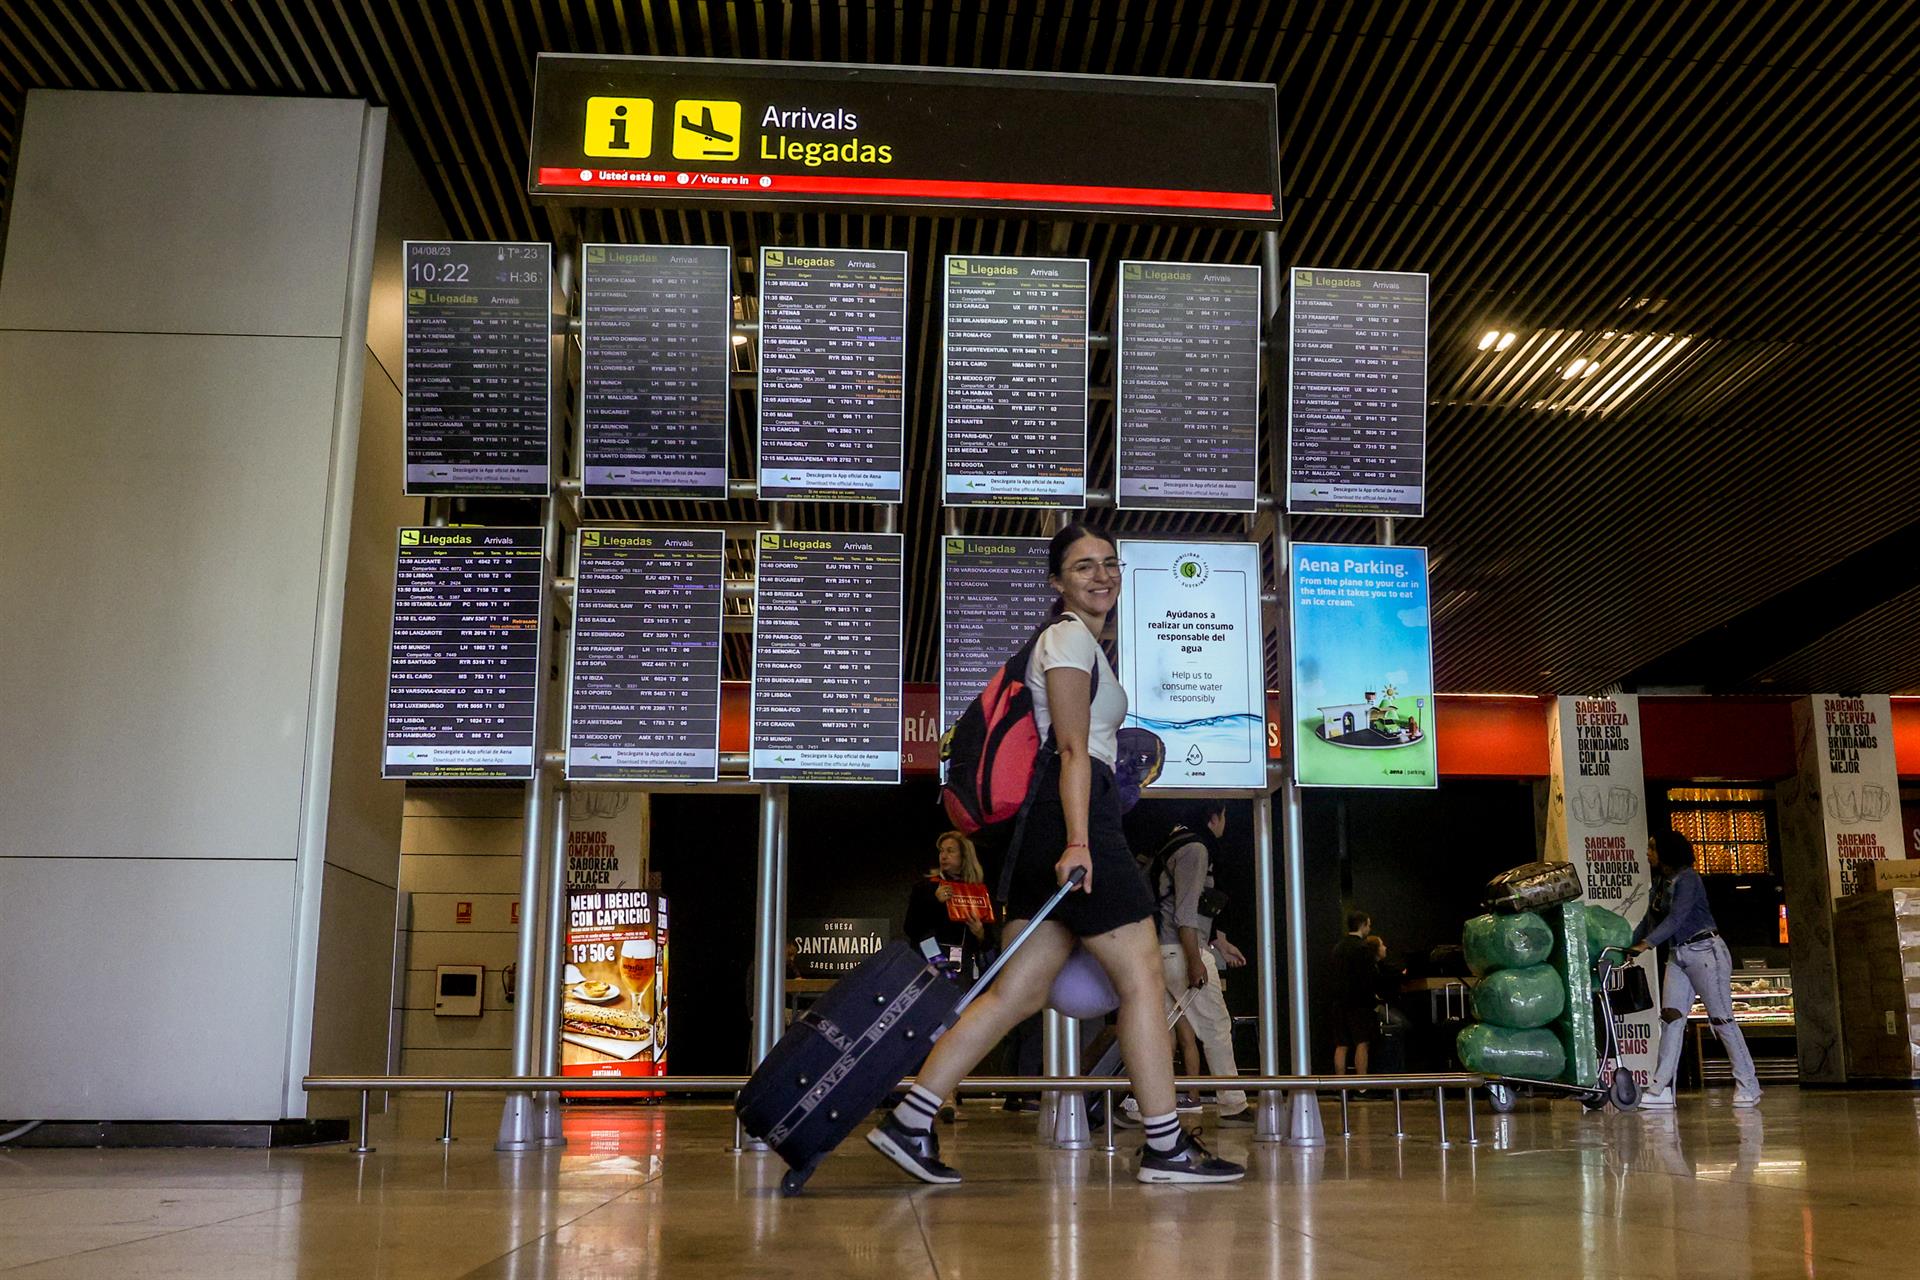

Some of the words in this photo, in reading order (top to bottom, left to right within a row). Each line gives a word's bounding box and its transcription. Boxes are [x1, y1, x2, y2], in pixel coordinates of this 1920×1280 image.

[761, 105, 857, 130] Arrivals
[760, 135, 892, 167] Llegadas
[599, 170, 628, 181] Usted
[630, 170, 651, 182] está
[653, 174, 665, 182] en
[700, 174, 719, 185] You
[721, 176, 738, 185] are
[740, 175, 749, 185] in
[412, 247, 451, 255] 04/08/23
[609, 253, 657, 263] Llegadas
[670, 256, 698, 264] Arrivals
[787, 256, 835, 268] Llegadas
[847, 260, 876, 269] Arrivals
[411, 263, 469, 282] 10:22
[971, 265, 1018, 275] Llegadas
[1030, 269, 1059, 277] Arrivals
[1145, 271, 1192, 281] Llegadas
[1204, 274, 1231, 282] Arrivals
[1316, 277, 1361, 287] Llegadas
[1373, 281, 1399, 289] Arrivals
[430, 293, 479, 304] Llegadas
[423, 535, 472, 545] Llegadas
[484, 537, 513, 545] Arrivals
[603, 536, 652, 546] Llegadas
[783, 539, 832, 550] Llegadas
[968, 544, 1016, 554] Llegadas
[1028, 547, 1050, 555] Arriva
[1300, 558, 1339, 573] Aena
[1344, 559, 1408, 578] Parking.
[1300, 577, 1321, 585] From
[1324, 578, 1337, 586] the
[1340, 578, 1362, 588] plane
[1301, 587, 1315, 595] the
[1338, 588, 1344, 596] it
[1371, 590, 1387, 598] you
[1328, 599, 1355, 607] cream.
[1166, 610, 1208, 619] Ayúdanos
[1158, 633, 1209, 641] responsable
[1172, 672, 1190, 680] Help
[1170, 695, 1215, 703] responsibly
[1576, 701, 1616, 713] SABEMOS
[1824, 700, 1864, 711] SABEMOS
[1576, 714, 1587, 725] DE
[1590, 714, 1628, 725] CERVEZA
[1826, 712, 1836, 724] DE
[1839, 712, 1876, 724] CERVEZA
[905, 710, 938, 742] RÍA
[1577, 727, 1582, 738] Y
[1585, 726, 1602, 738] POR
[1605, 726, 1621, 738] ESO
[1827, 725, 1831, 736] Y
[1835, 724, 1850, 736] POR
[1854, 725, 1869, 736] ESO
[1578, 738, 1629, 750] BRINDAMOS
[1828, 737, 1877, 748] BRINDAMOS
[1579, 751, 1596, 763] CON
[1599, 751, 1610, 763] LA
[1830, 749, 1846, 760] CON
[1849, 749, 1859, 761] LA
[1580, 764, 1610, 776] MEJOR
[1830, 762, 1859, 773] MEJOR
[568, 832, 607, 844] ABEMOS
[1585, 837, 1625, 849] SABEMOS
[1837, 834, 1876, 845] SABEMOS
[569, 845, 615, 857] OMPARTIR
[1586, 849, 1635, 861] COMPARTIR
[1838, 846, 1886, 858] COMPARTIR
[570, 858, 618, 870] SABOREAR
[1586, 862, 1592, 874] Y
[1594, 862, 1640, 874] SABOREAR
[1839, 859, 1843, 870] Y
[567, 871, 572, 884] L
[575, 871, 610, 884] PLACER
[1588, 875, 1597, 886] EL
[1600, 875, 1632, 886] PLACER
[1841, 871, 1850, 882] EL
[1589, 886, 1622, 899] IBÉRICO
[571, 893, 602, 911] MENÚ
[605, 892, 648, 908] IBÉRICO
[571, 910, 593, 927] CON
[597, 908, 650, 926] CAPRICHO
[825, 923, 853, 931] DEHESA
[795, 932, 882, 954] SANTAMARÍA
[810, 961, 834, 970] SABER
[837, 961, 861, 970] IBÉR
